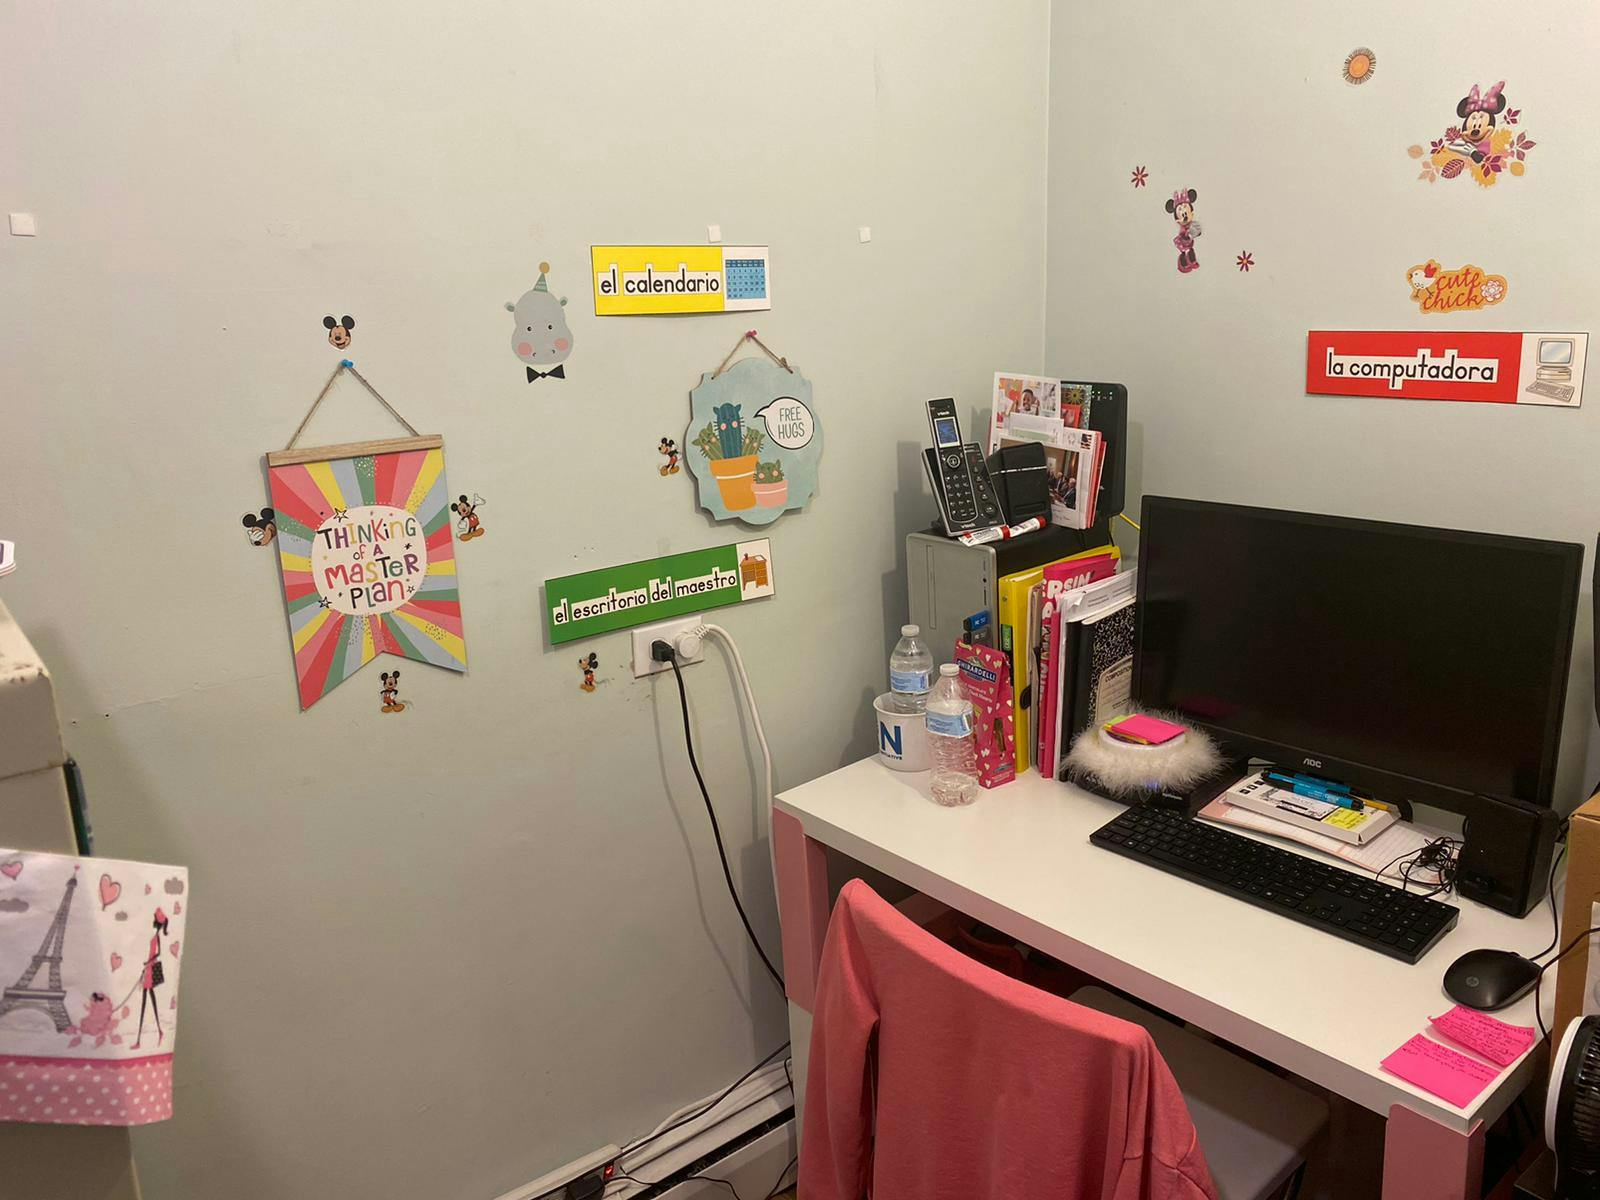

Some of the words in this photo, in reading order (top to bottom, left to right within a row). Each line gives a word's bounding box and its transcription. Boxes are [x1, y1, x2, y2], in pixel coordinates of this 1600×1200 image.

[600, 268, 617, 294] el
[625, 268, 719, 293] calendario
[1436, 268, 1482, 290] cute
[1423, 288, 1484, 310] chick
[1328, 352, 1344, 376] la
[1349, 354, 1494, 388] computadora
[779, 406, 802, 422] FREE
[777, 422, 805, 440] HUGS
[352, 543, 366, 561] of
[373, 543, 384, 556] A
[554, 602, 569, 623] el
[573, 591, 647, 620] escritorio
[651, 580, 672, 602] del
[676, 570, 736, 597] maestro
[880, 720, 903, 755] N
[1302, 757, 1322, 769] AOC
